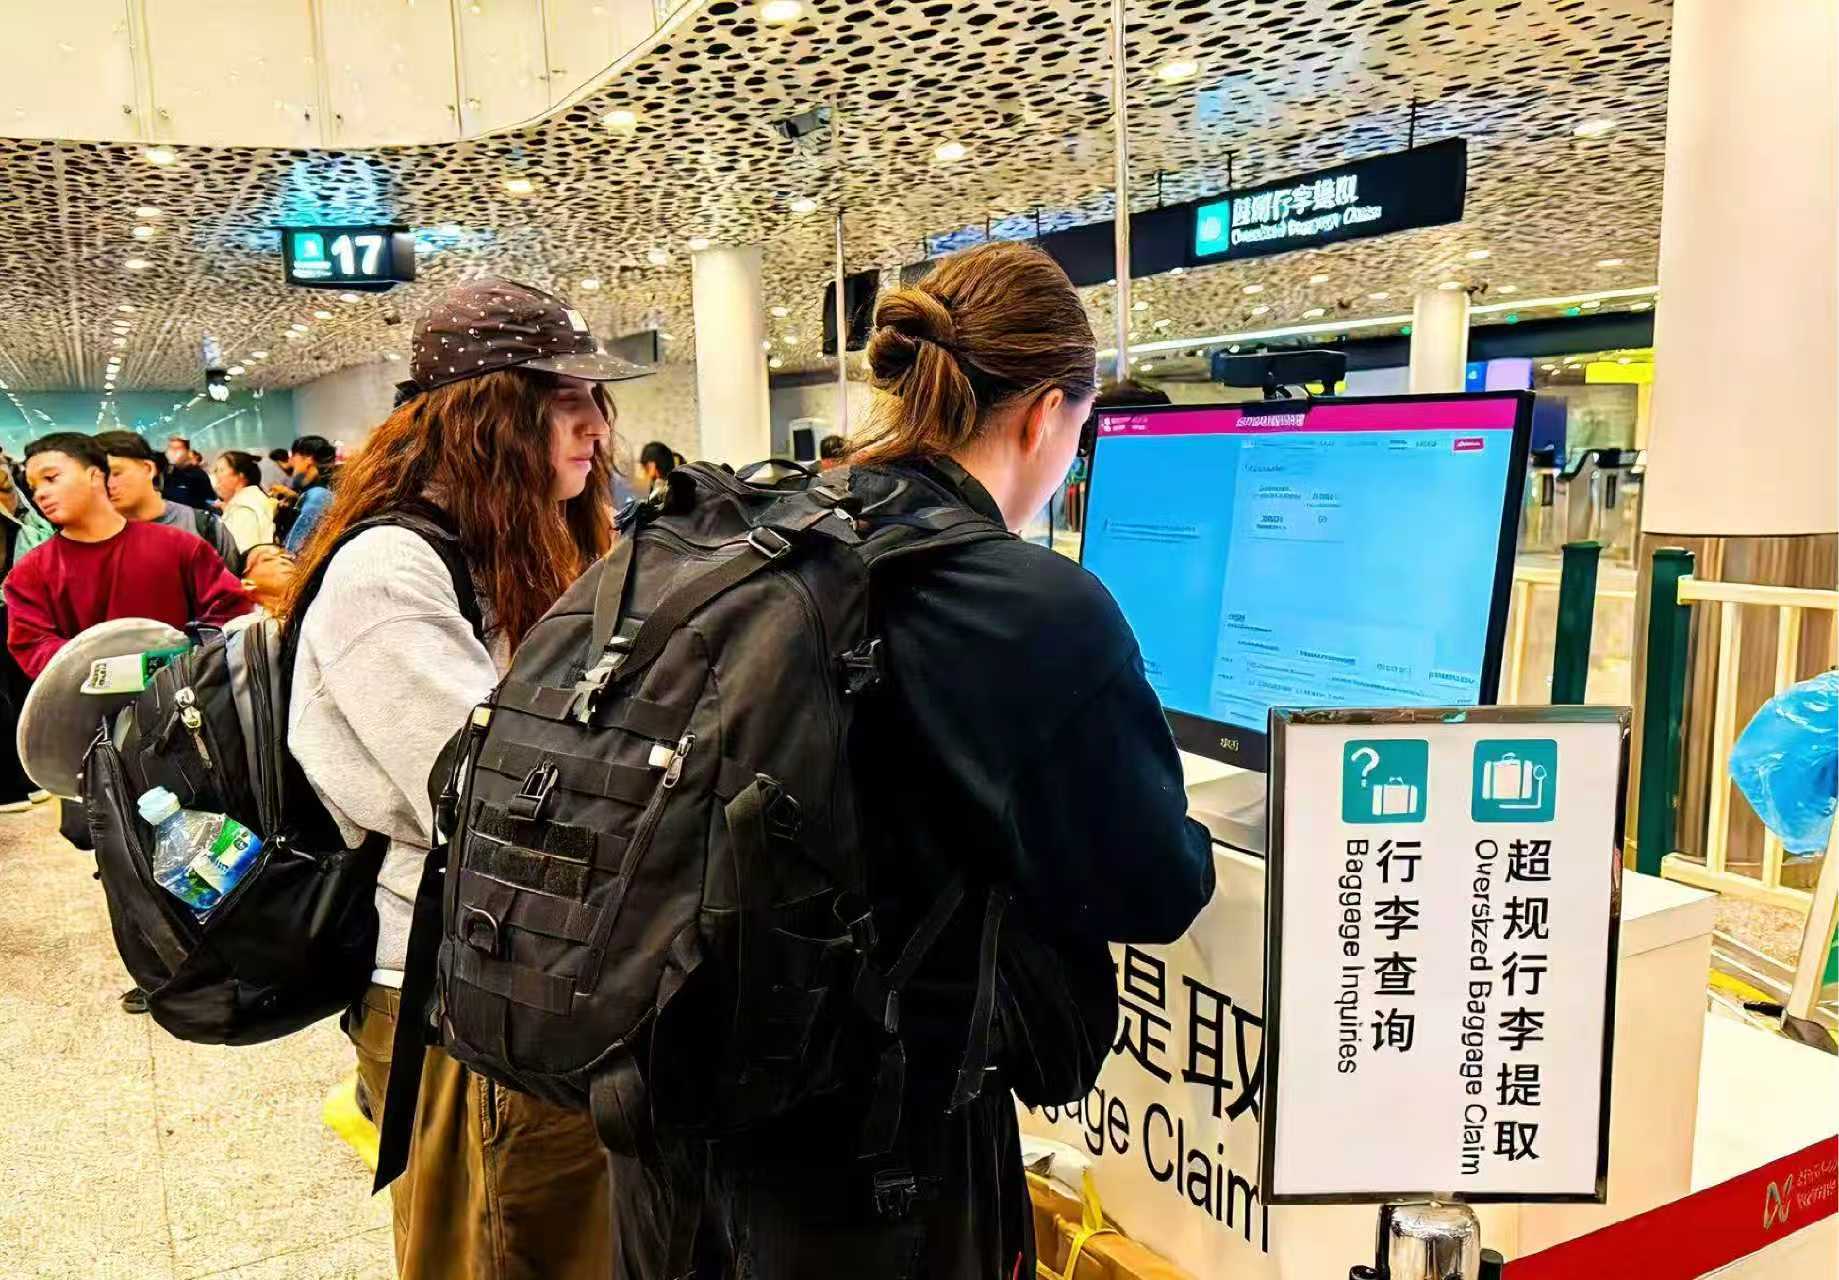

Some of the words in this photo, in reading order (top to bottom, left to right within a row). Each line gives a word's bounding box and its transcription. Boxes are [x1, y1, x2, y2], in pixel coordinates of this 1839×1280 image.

[331, 234, 382, 275] 17
[1338, 839, 1369, 957] Baggage
[1371, 839, 1422, 1053] 行李查询
[1470, 839, 1498, 971] Oversized
[1334, 965, 1365, 1074] Inquiries
[1459, 981, 1493, 1095] Baggage
[1493, 838, 1552, 1161] 超规行李提取
[1143, 1102, 1269, 1253] Claim
[1461, 1104, 1487, 1175] Claim
